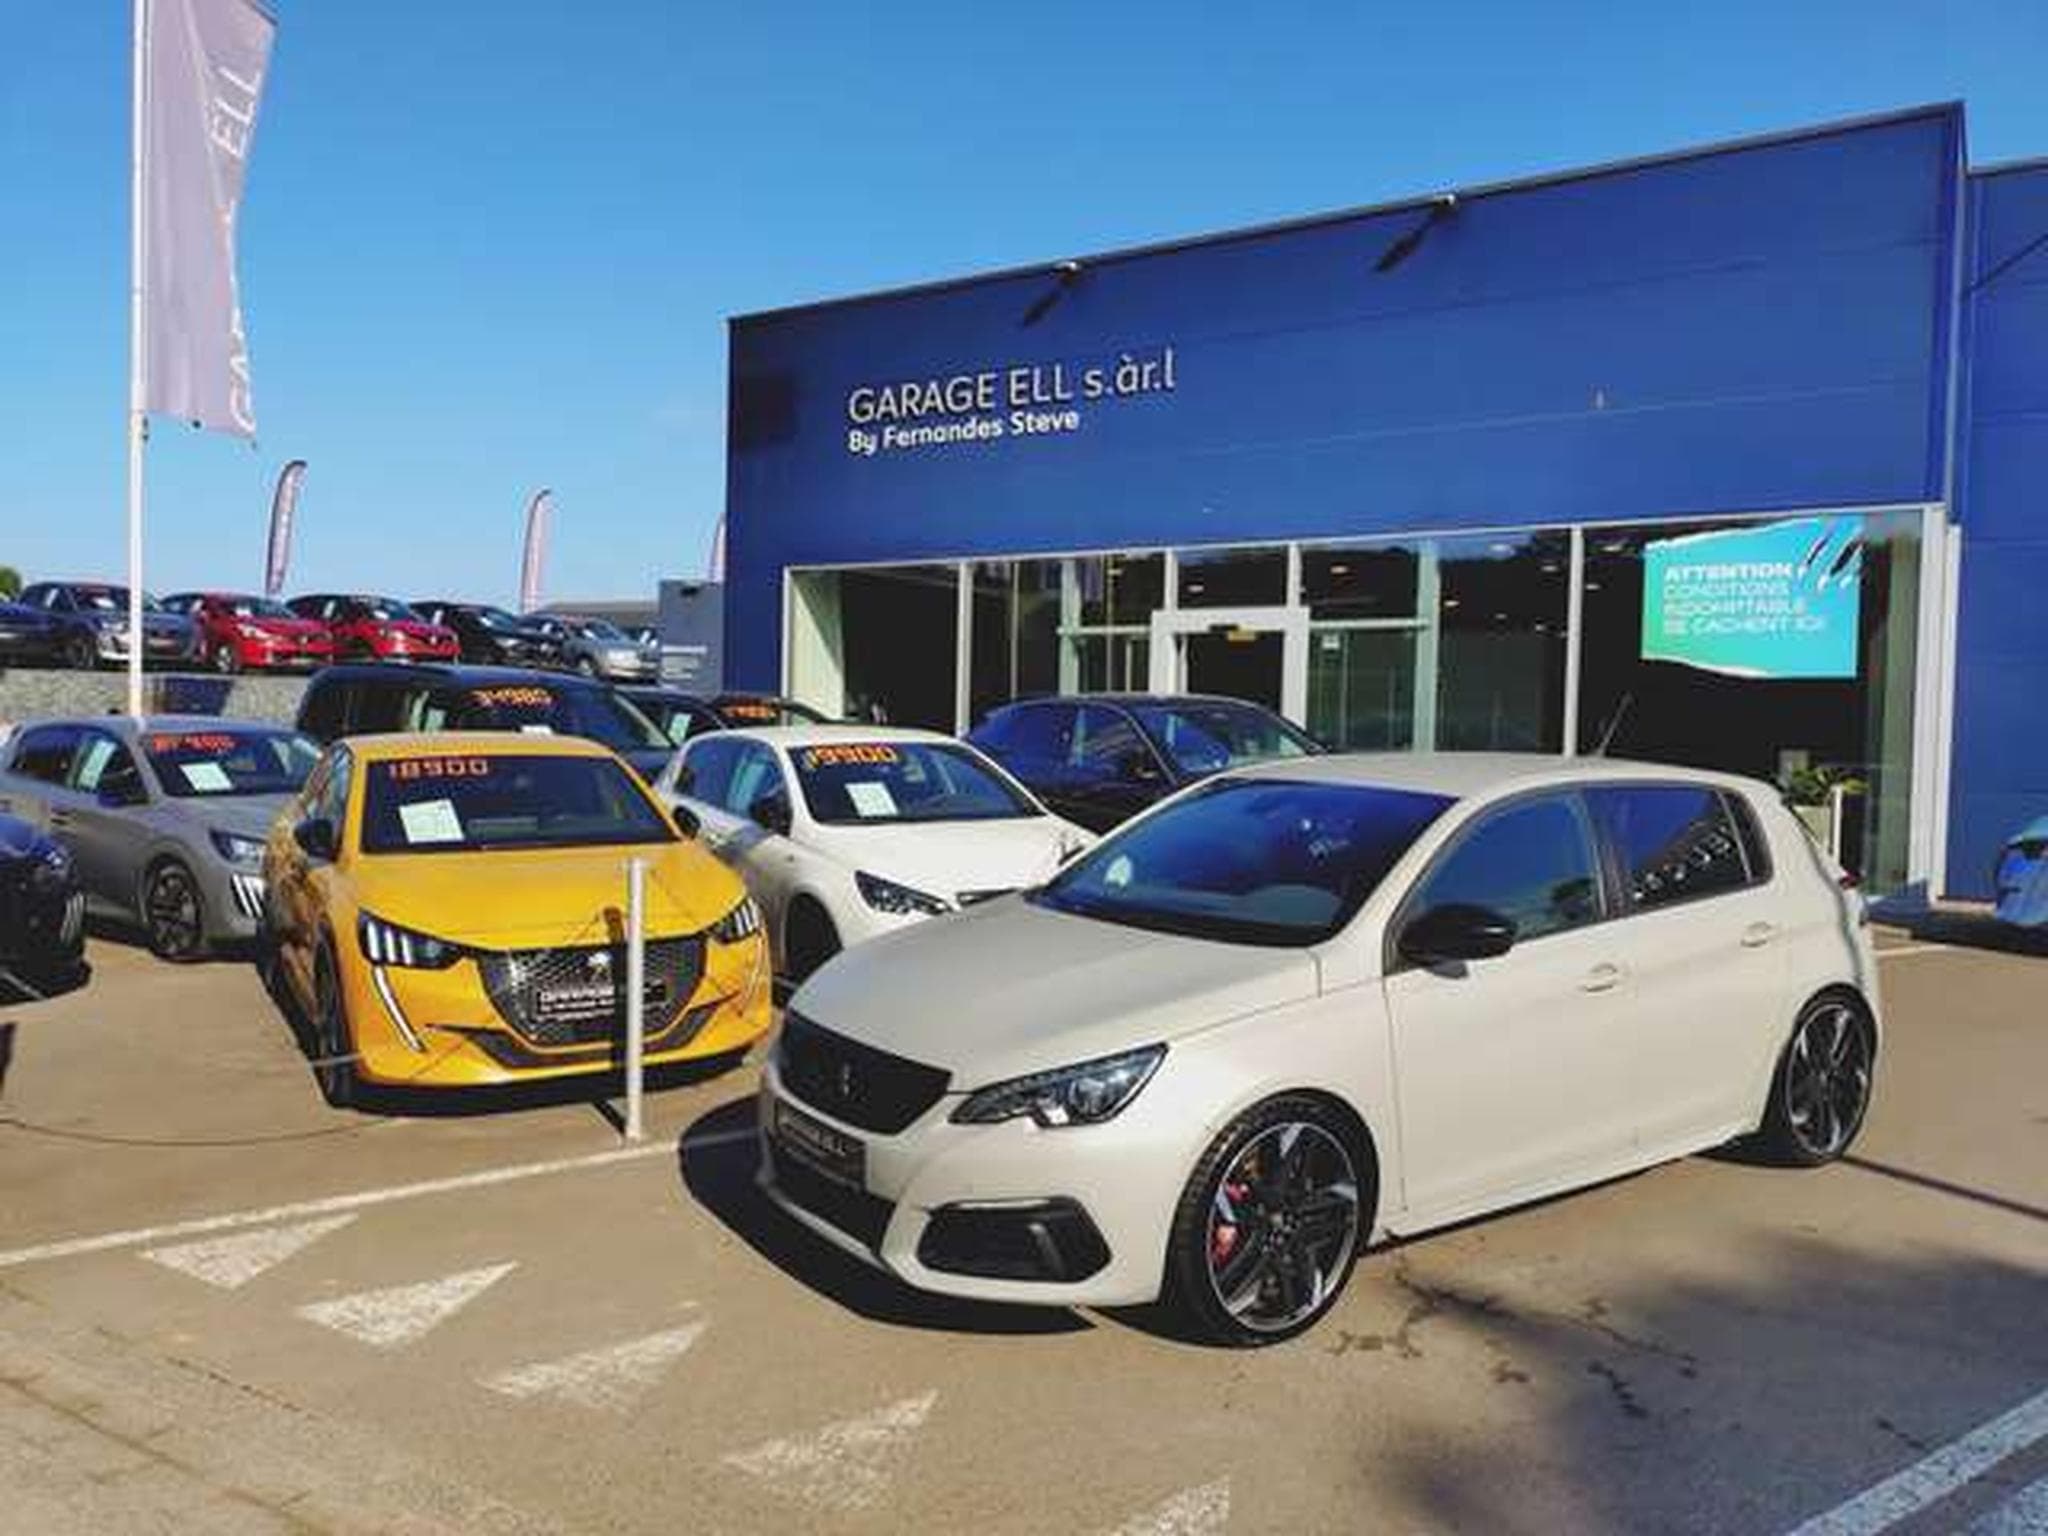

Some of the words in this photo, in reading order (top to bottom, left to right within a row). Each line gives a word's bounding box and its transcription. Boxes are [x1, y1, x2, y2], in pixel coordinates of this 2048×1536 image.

[210, 66, 261, 160] ELL
[848, 372, 998, 422] GARAGE
[1009, 364, 1074, 404] ELL
[848, 430, 876, 455] By
[883, 417, 1003, 448] Fernandes
[1010, 410, 1080, 434] Steve
[1664, 563, 1793, 581] ATTENTION
